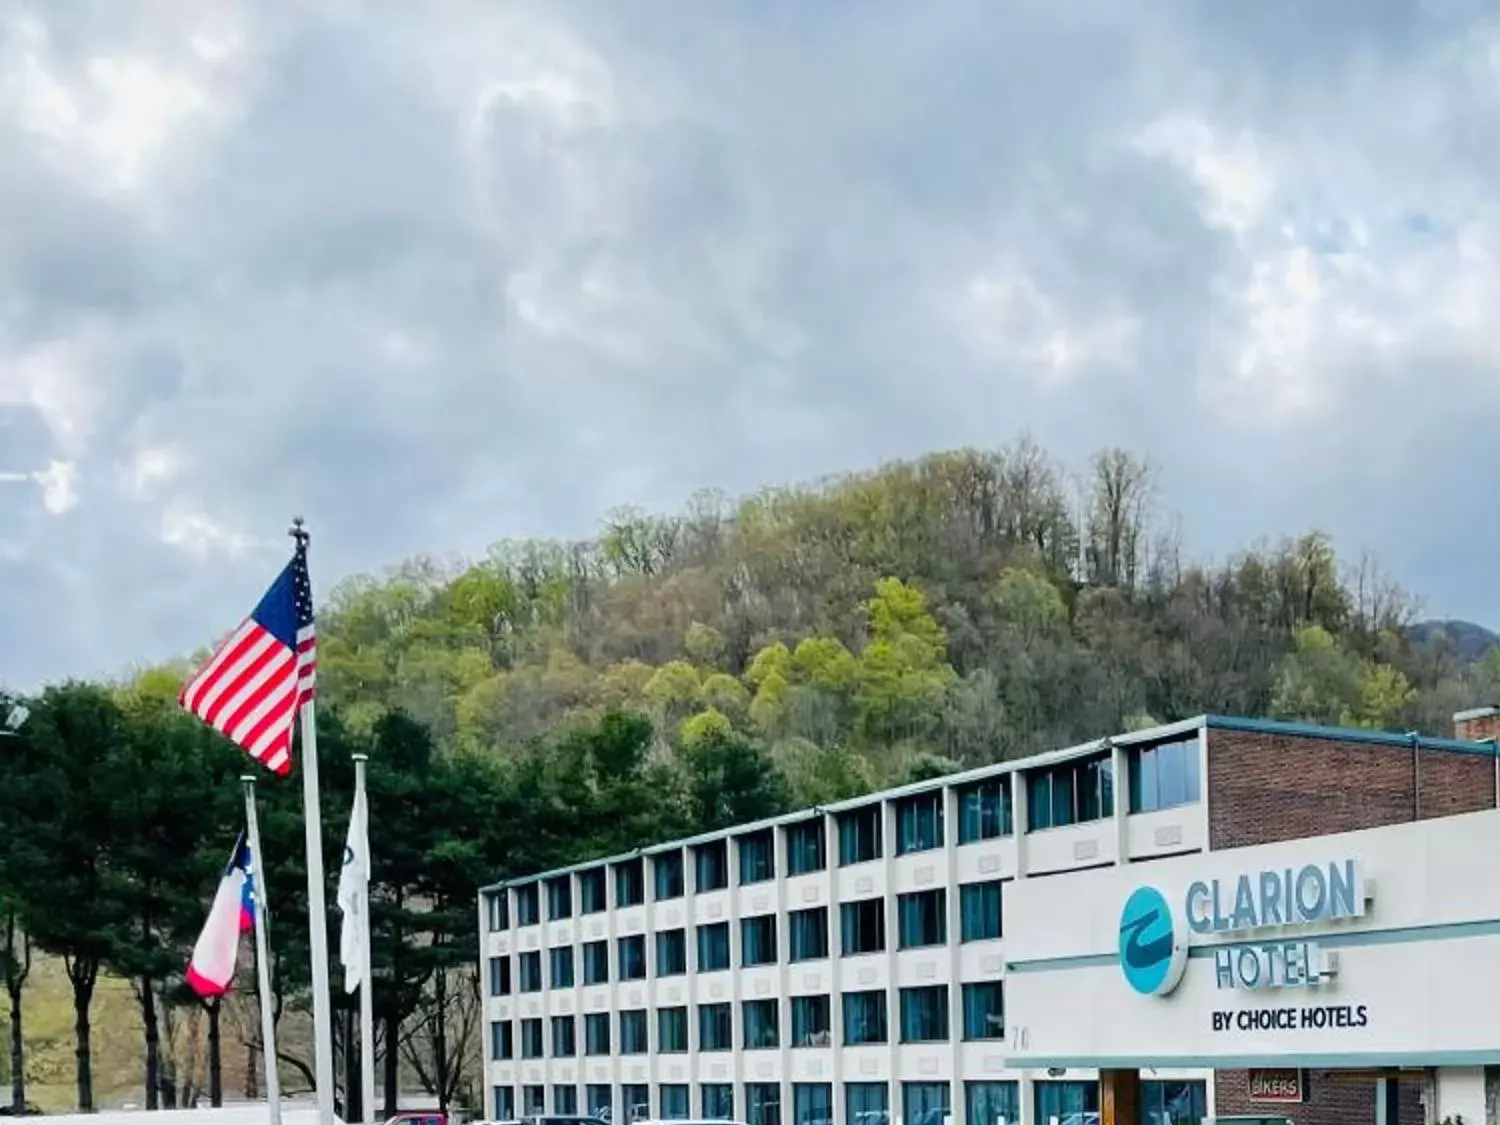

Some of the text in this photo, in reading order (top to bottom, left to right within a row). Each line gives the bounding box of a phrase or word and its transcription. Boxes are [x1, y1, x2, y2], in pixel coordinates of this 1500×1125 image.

[1186, 859, 1356, 934] CLARION
[1215, 944, 1319, 990] HOTEL
[1212, 1005, 1368, 1031] BY CHOICE HOTELS
